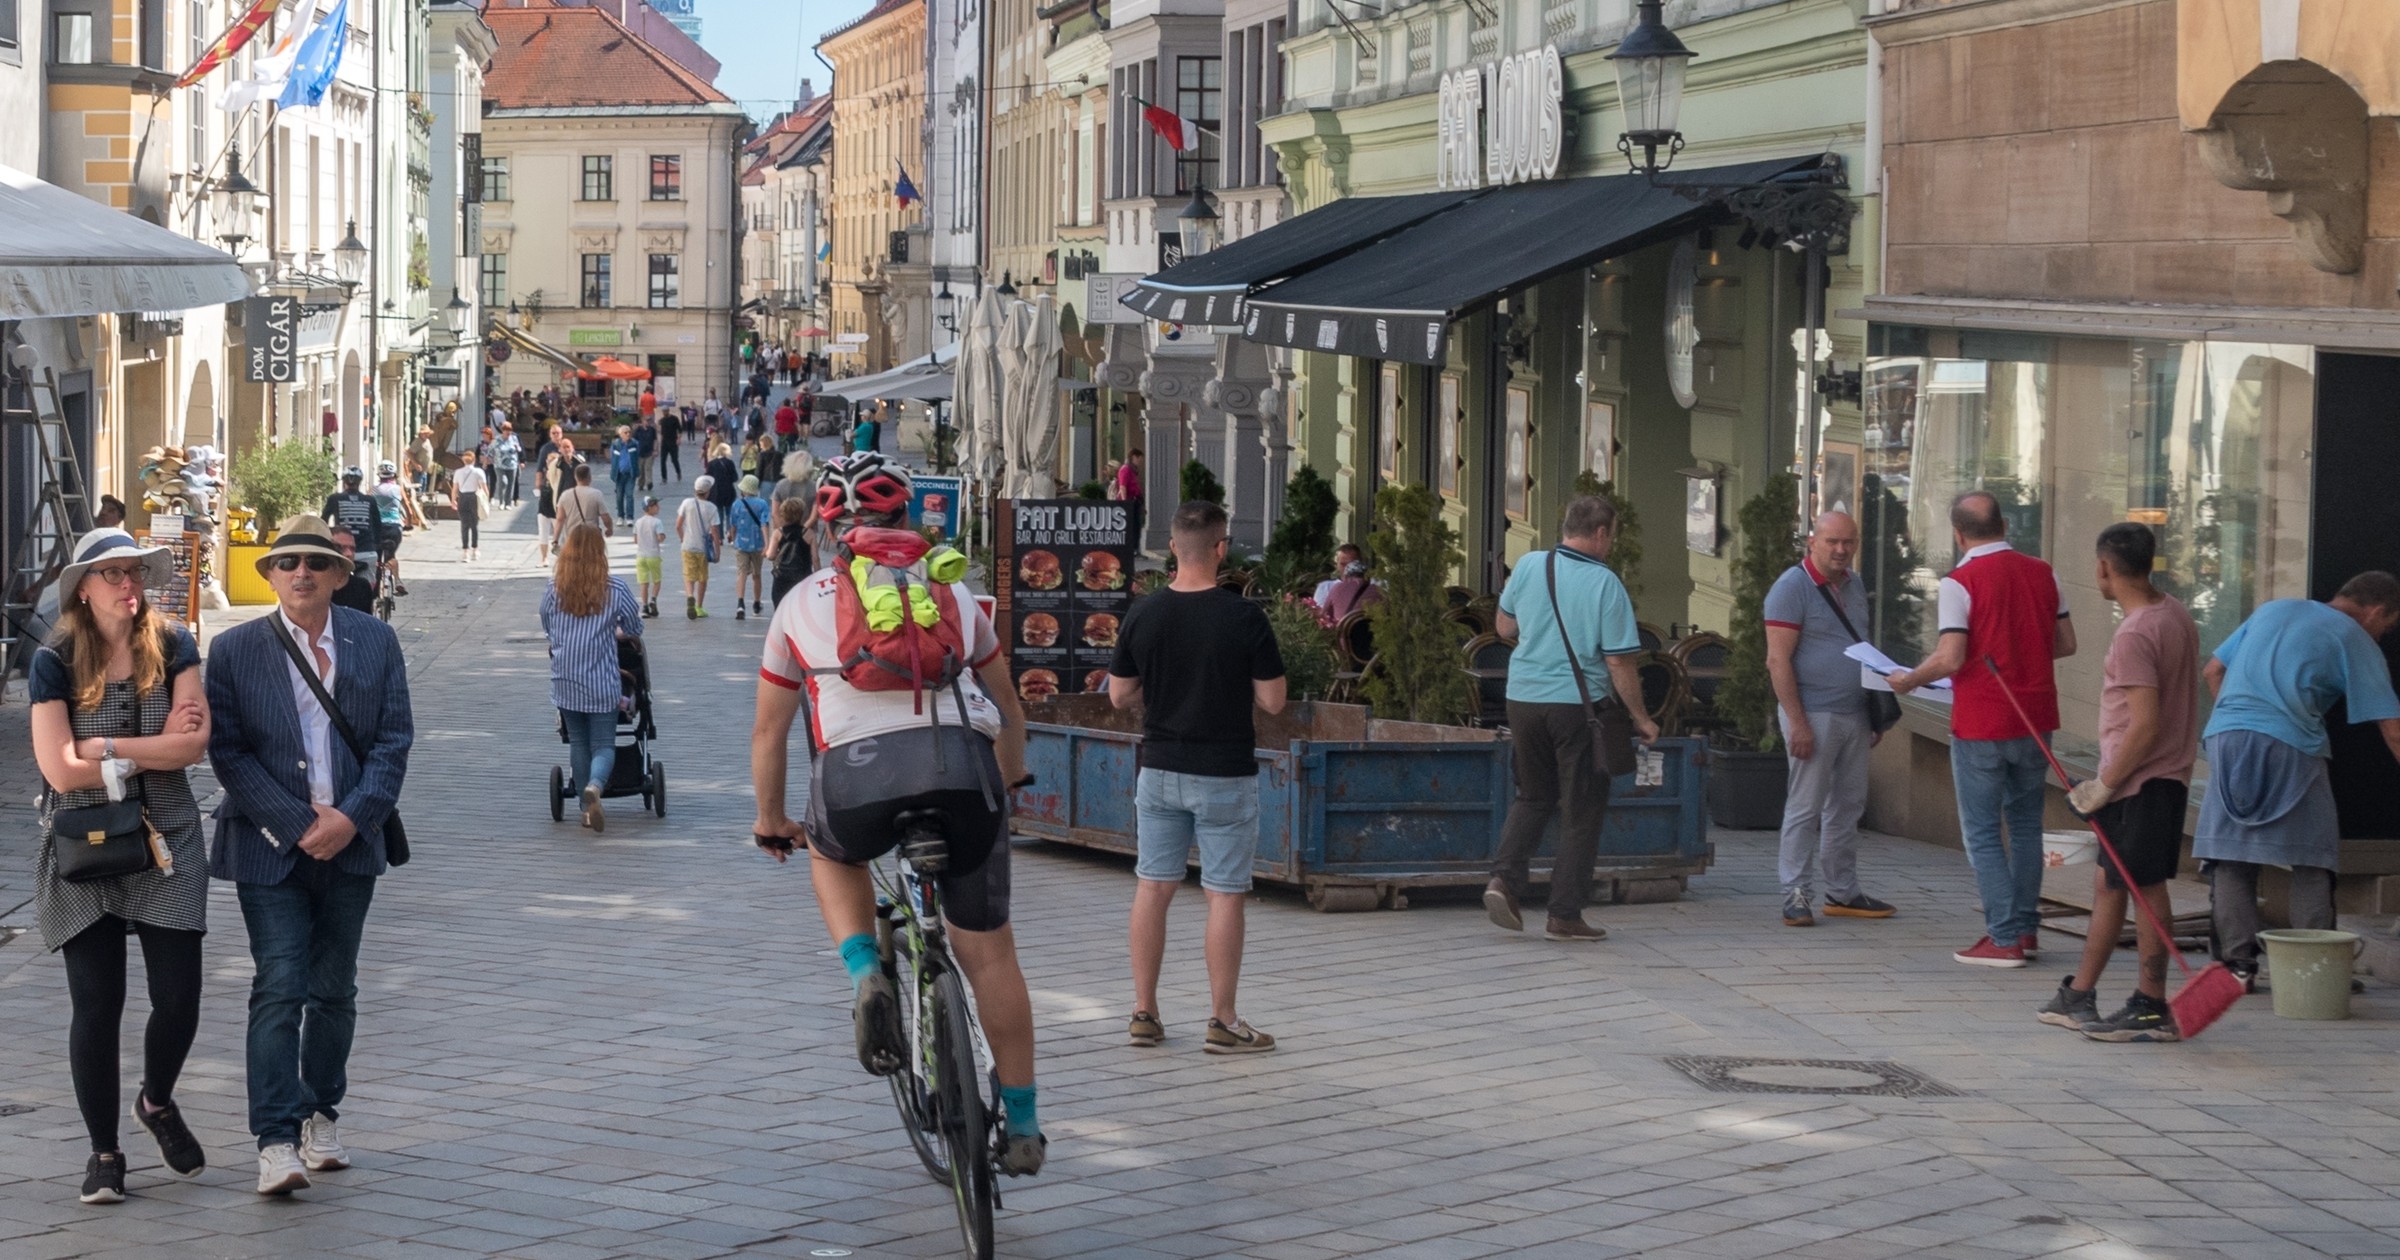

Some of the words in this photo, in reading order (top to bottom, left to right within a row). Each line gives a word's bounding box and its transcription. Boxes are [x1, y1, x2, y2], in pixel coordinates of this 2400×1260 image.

[1438, 70, 1482, 189] FAT
[1486, 43, 1562, 186] LOUIS
[466, 137, 477, 200] HOTEL
[266, 298, 290, 381] CIGÁR
[252, 346, 264, 380] DOM
[912, 481, 959, 490] COCCINELLE
[1016, 506, 1059, 530] FAT
[1064, 506, 1127, 531] LOUIS
[1016, 531, 1032, 545] BAR
[1034, 531, 1051, 545] AND
[1054, 531, 1076, 545] GRILL
[1079, 530, 1126, 545] RESTAURANT
[997, 558, 1012, 611] BURGERS
